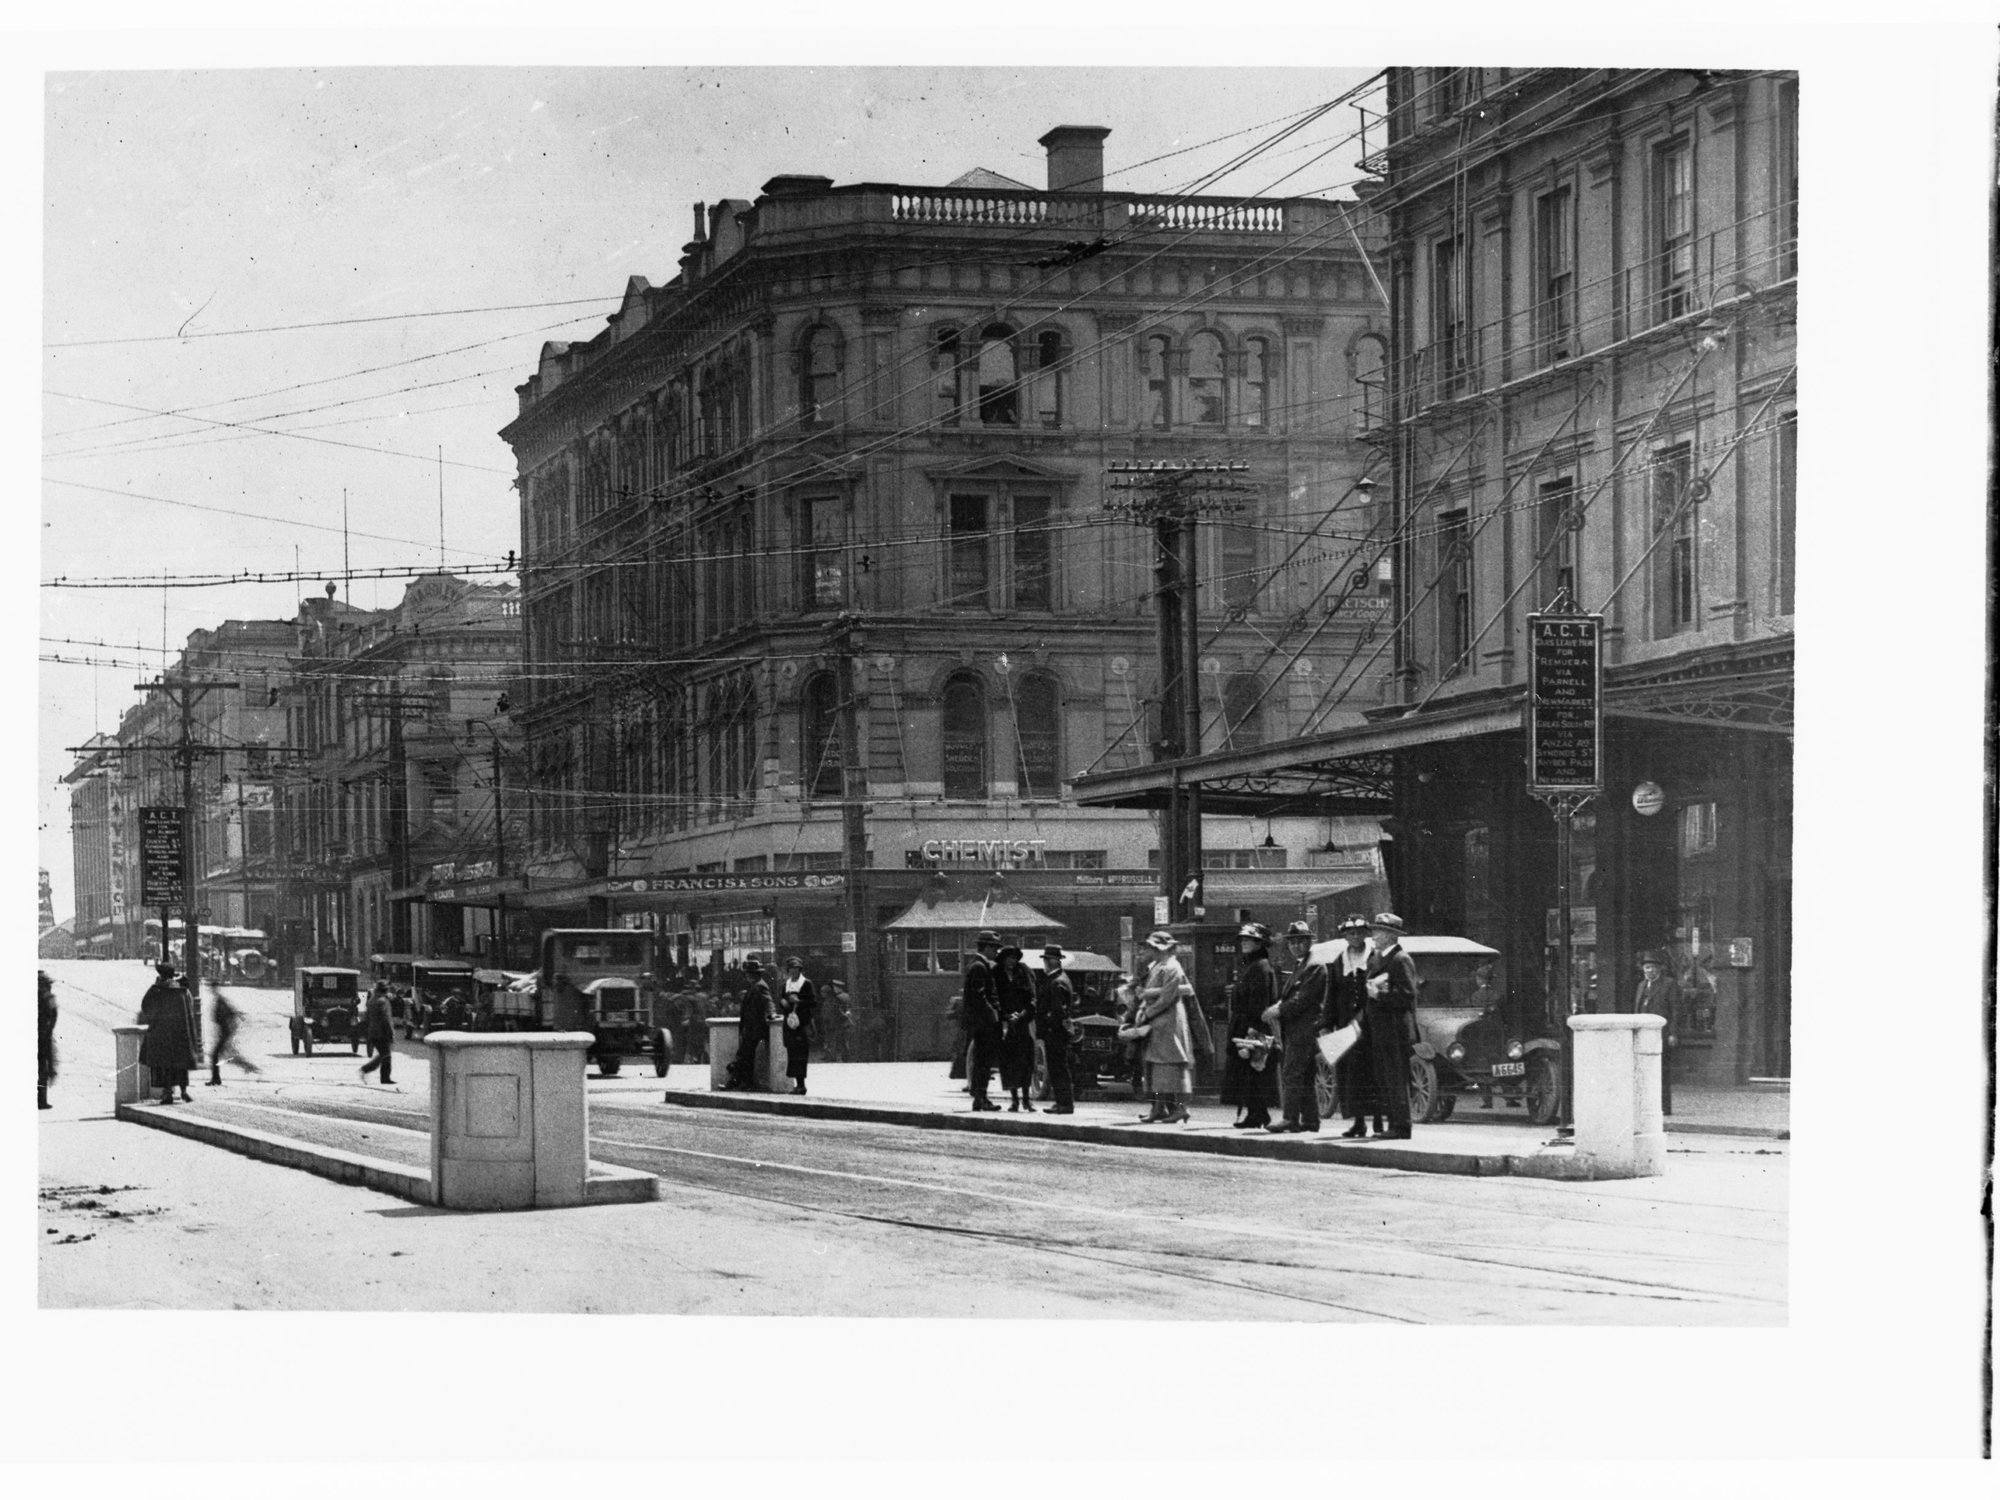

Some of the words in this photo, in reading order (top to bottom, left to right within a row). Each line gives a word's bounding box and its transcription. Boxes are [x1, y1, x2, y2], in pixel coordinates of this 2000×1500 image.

[1540, 656, 1589, 666] REMUERA
[1556, 669, 1572, 677] VIA
[1542, 677, 1587, 686] PARNELL
[1554, 688, 1576, 696] AND
[1538, 698, 1592, 706] NEWMARKET
[923, 840, 1047, 862] CHEMIST
[652, 878, 737, 890] FRANCIS
[750, 875, 799, 887] SONS
